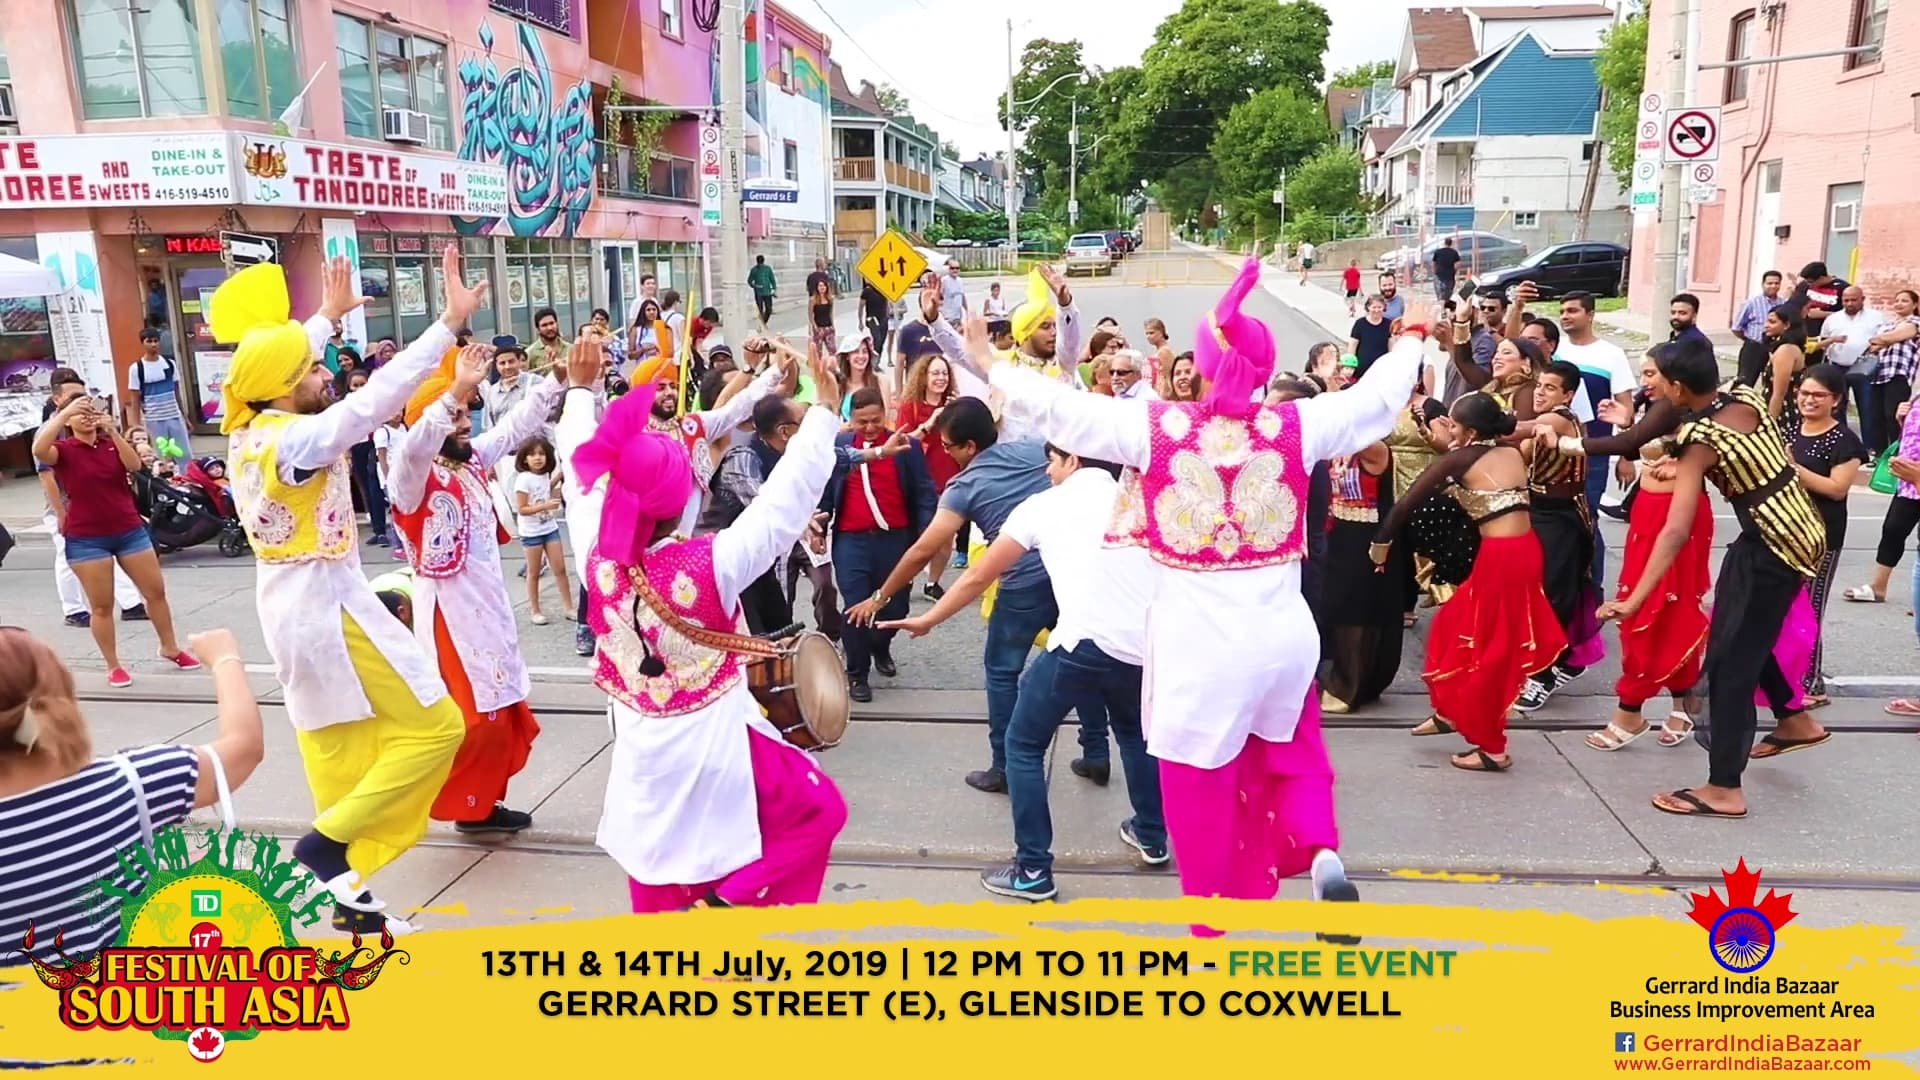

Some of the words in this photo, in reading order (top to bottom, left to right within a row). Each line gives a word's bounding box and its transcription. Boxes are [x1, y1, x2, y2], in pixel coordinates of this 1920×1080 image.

[152, 149, 206, 161] DINE-IN
[213, 148, 222, 159] &
[102, 161, 129, 179] AND
[152, 164, 225, 176] TAKE-OUT
[305, 147, 401, 181] TASTE
[405, 169, 417, 183] OF
[467, 174, 498, 186] DINE-IN
[0, 175, 85, 201] OREE
[89, 183, 150, 201] SWEETS
[155, 187, 229, 200] 416-519-4510
[293, 176, 428, 209] TANDOOREE
[467, 188, 506, 201] TAKE-OUT
[431, 193, 465, 211] SWEETS
[749, 191, 778, 201] Gerrard
[787, 192, 792, 201] E
